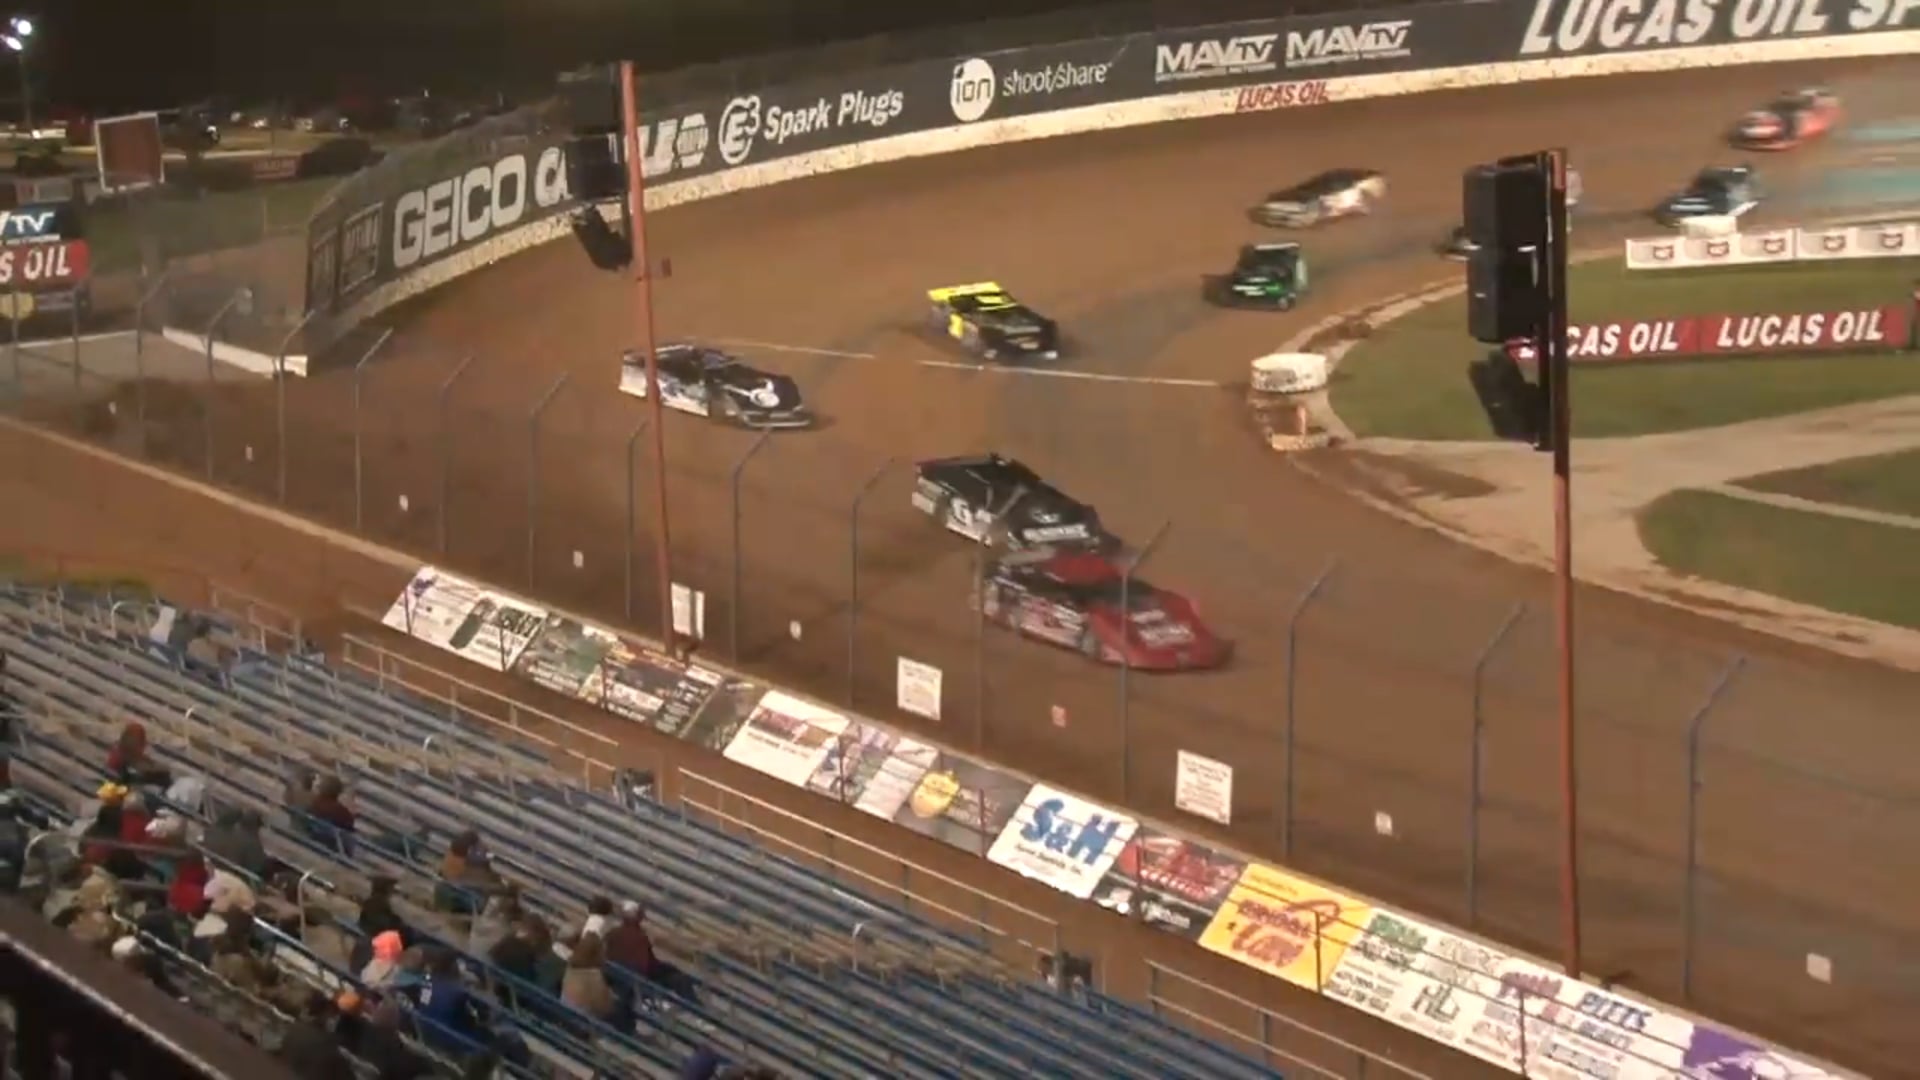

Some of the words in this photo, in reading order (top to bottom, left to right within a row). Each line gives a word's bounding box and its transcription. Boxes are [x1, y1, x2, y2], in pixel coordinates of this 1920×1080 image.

[1519, 0, 1716, 54] LUCAS
[1730, 0, 1829, 38] OIL
[764, 104, 832, 144] Spark
[837, 87, 904, 126] Plugs
[1235, 86, 1296, 112] LUCAS
[1298, 82, 1331, 105] OIL
[393, 154, 527, 268] GEICO
[24, 245, 72, 280] OIL
[1628, 320, 1680, 355] OIL
[1717, 312, 1825, 348] LUCAS
[1832, 309, 1885, 343] OIL
